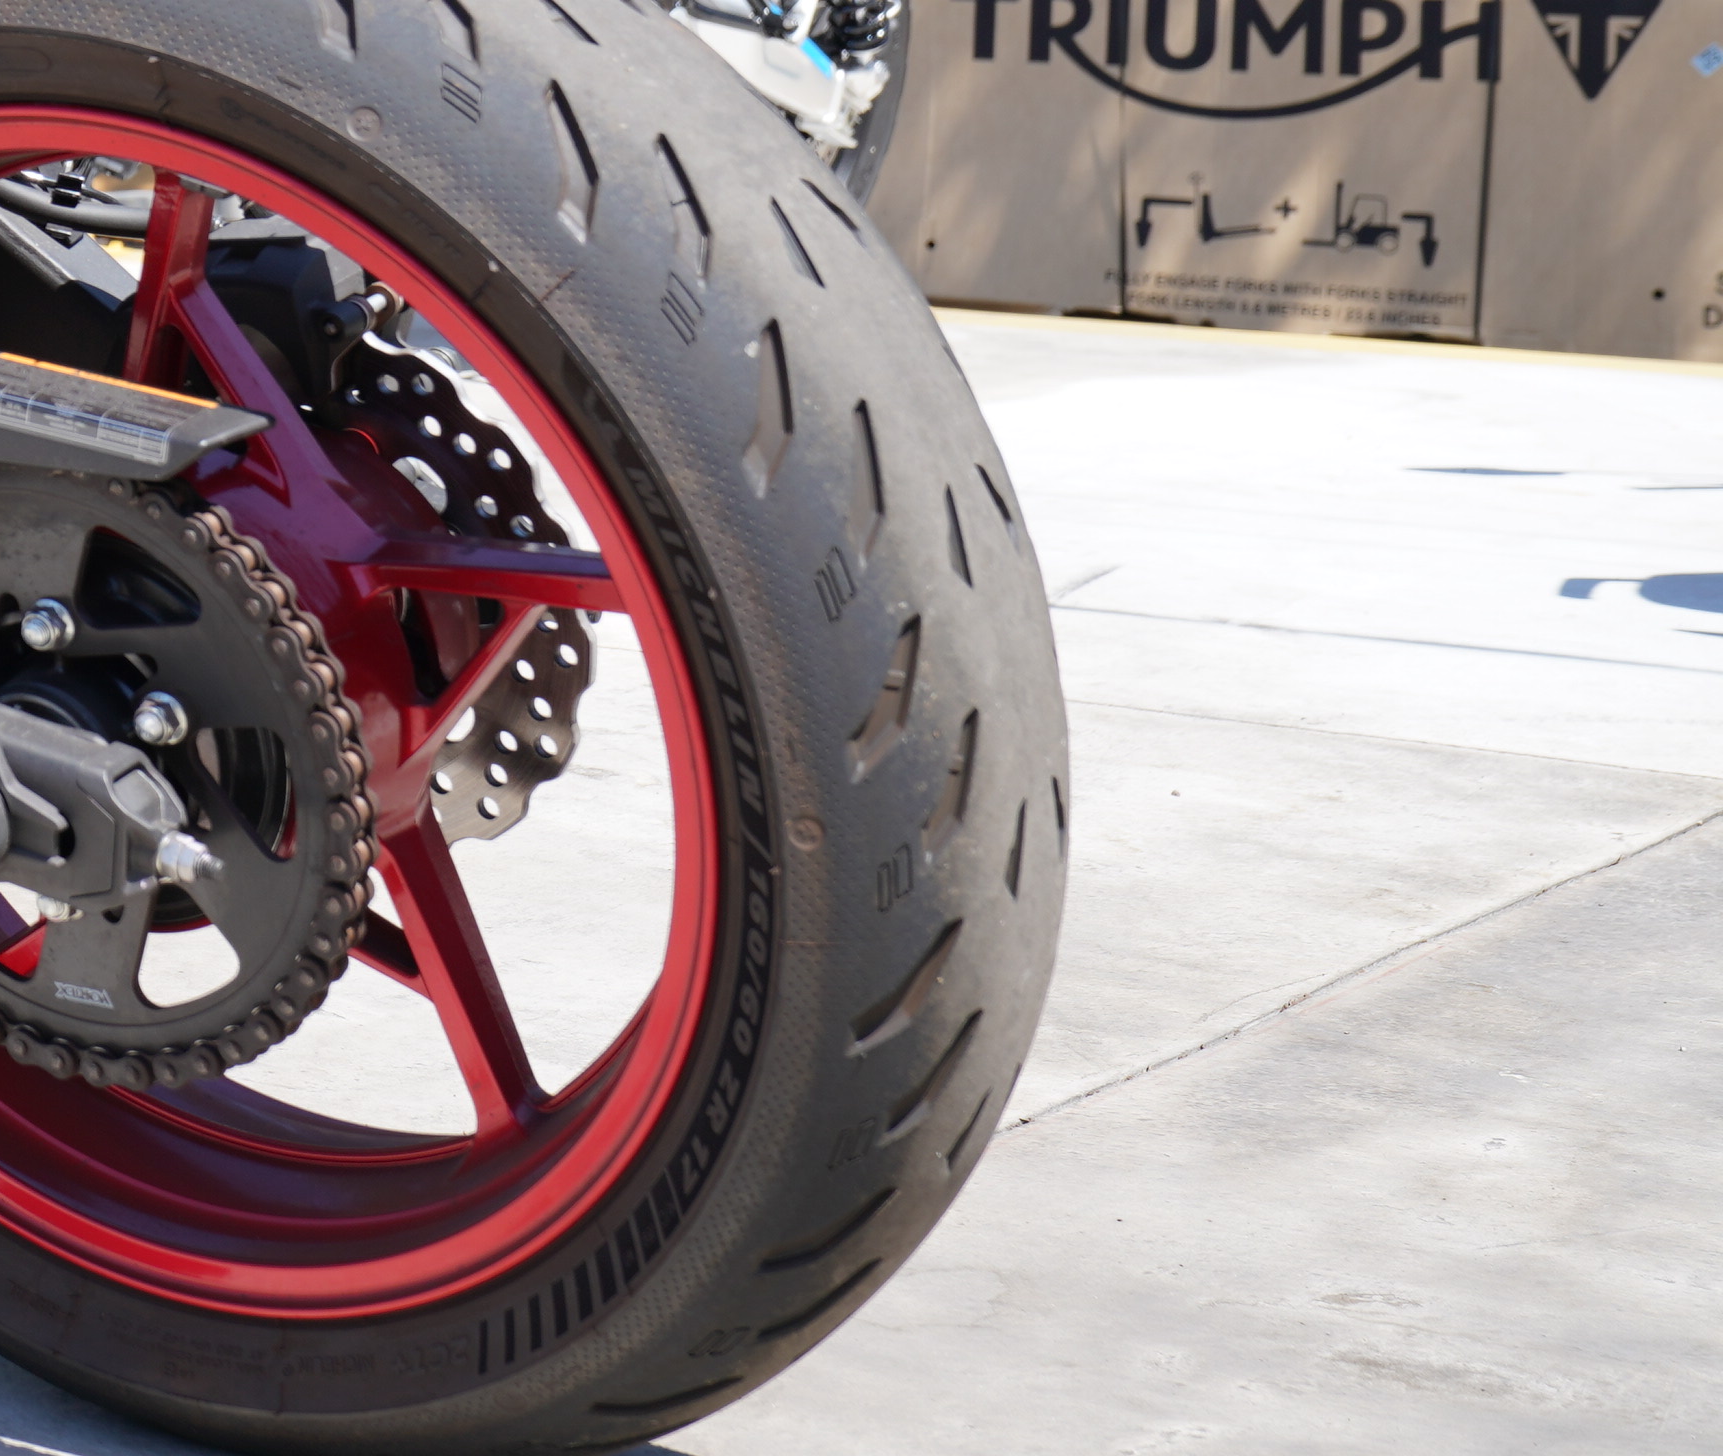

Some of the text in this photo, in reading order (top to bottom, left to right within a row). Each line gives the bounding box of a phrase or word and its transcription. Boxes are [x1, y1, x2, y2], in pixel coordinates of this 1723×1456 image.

[627, 463, 771, 1195] MICHELIN 160/60 ZR 17
